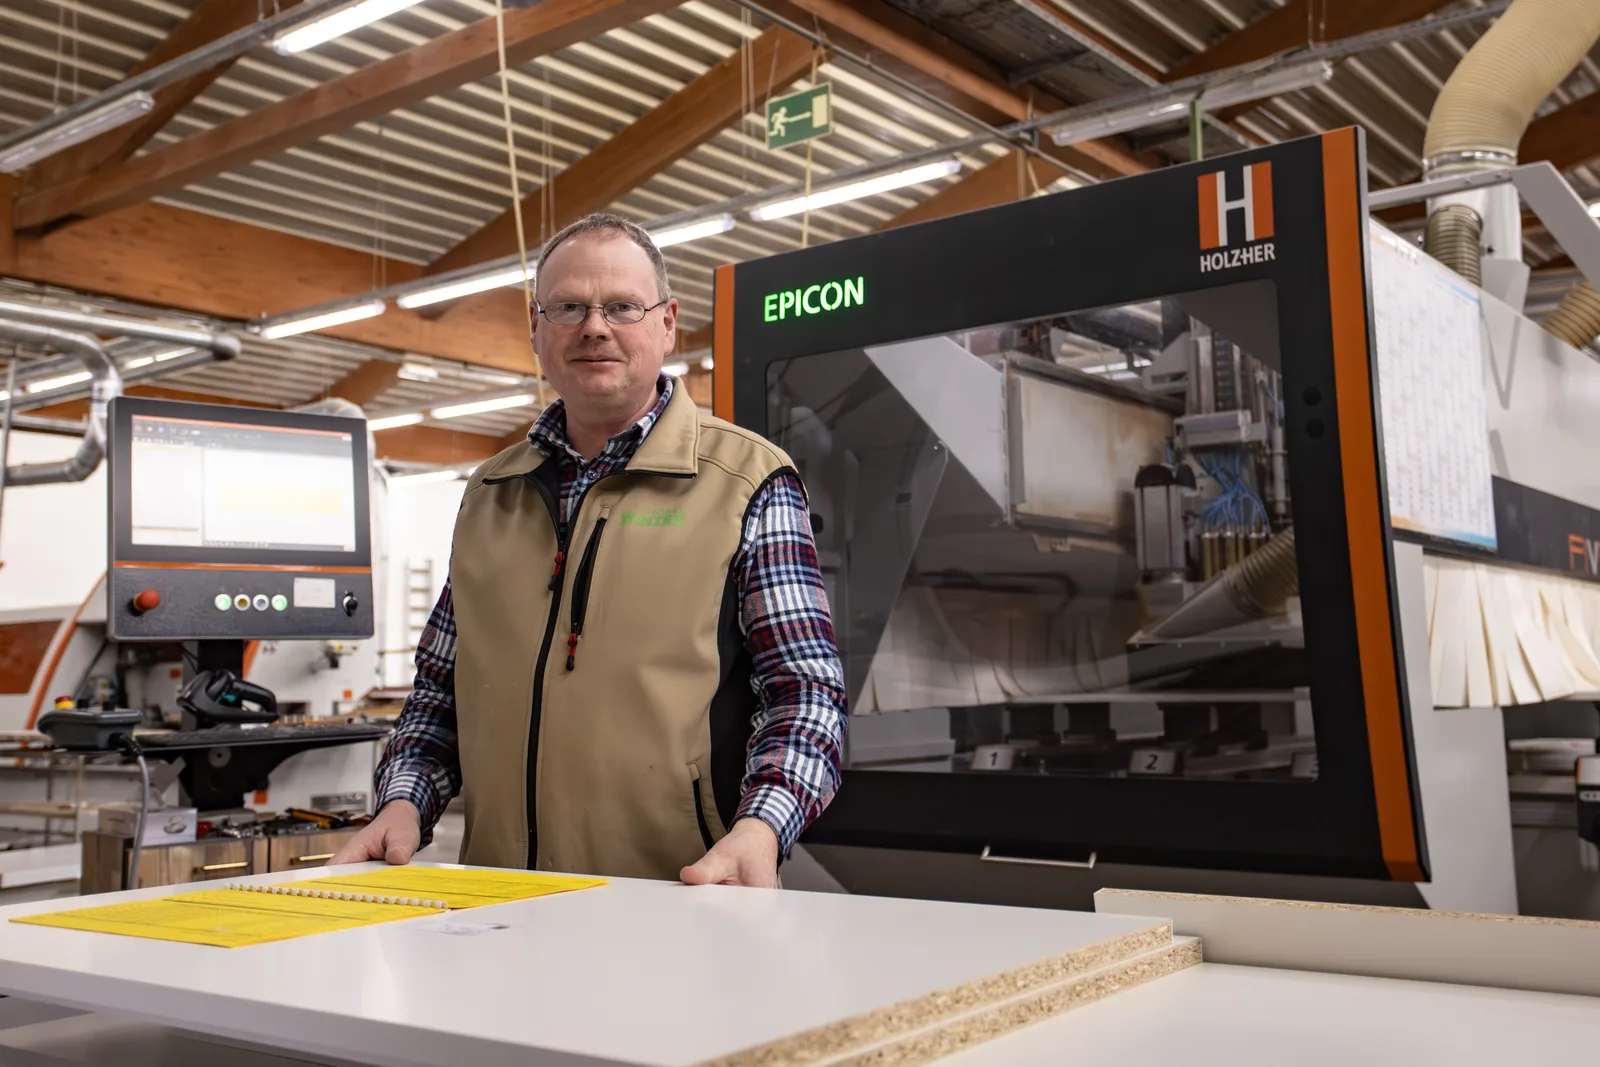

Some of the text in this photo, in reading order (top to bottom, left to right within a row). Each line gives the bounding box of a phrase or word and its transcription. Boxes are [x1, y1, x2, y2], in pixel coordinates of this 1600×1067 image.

[764, 276, 864, 323] EPICON
[990, 751, 998, 767] 1
[1145, 754, 1158, 771] 2
